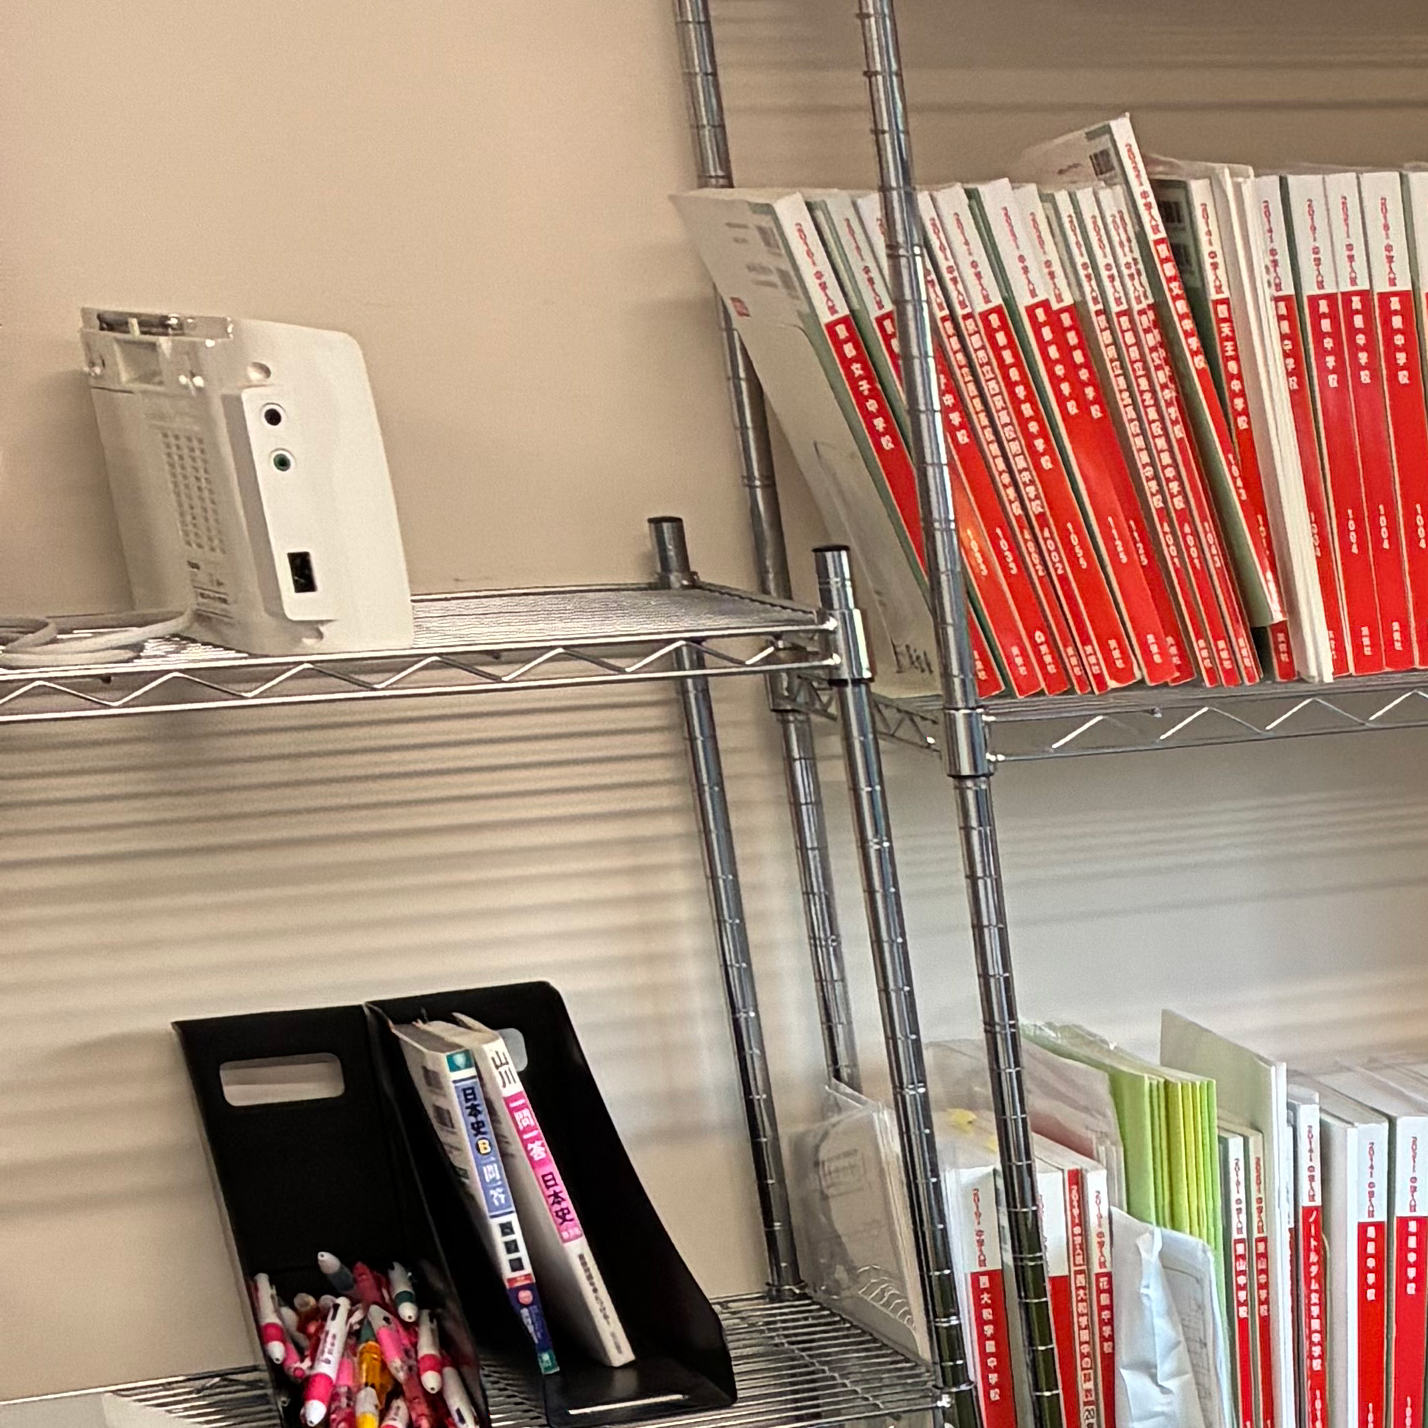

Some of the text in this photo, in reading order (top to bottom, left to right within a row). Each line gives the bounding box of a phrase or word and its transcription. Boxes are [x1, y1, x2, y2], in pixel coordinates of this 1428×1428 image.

[1140, 190, 1161, 234] 中学入試
[1208, 252, 1224, 294] 中学入試
[1269, 248, 1282, 292] 中学入試
[1311, 246, 1327, 290] 中学入試
[1348, 509, 1358, 554] 1004
[1345, 243, 1359, 286] 中学入試
[1379, 505, 1390, 549] 1004
[1384, 243, 1398, 287] 中学入試
[1415, 504, 1427, 549] 1004
[491, 1050, 575, 1224] 山川 一問一答 日本史
[1307, 1166, 1316, 1203] 中学入試
[1235, 1198, 1244, 1235] 中学入試
[1256, 1197, 1264, 1234] 中学入試
[975, 1229, 987, 1268] 中学入試
[1073, 1228, 1084, 1265] 中学入試
[1096, 1231, 1106, 1269] 中学入試
[978, 1276, 1000, 1401] 西大和学園中学校
